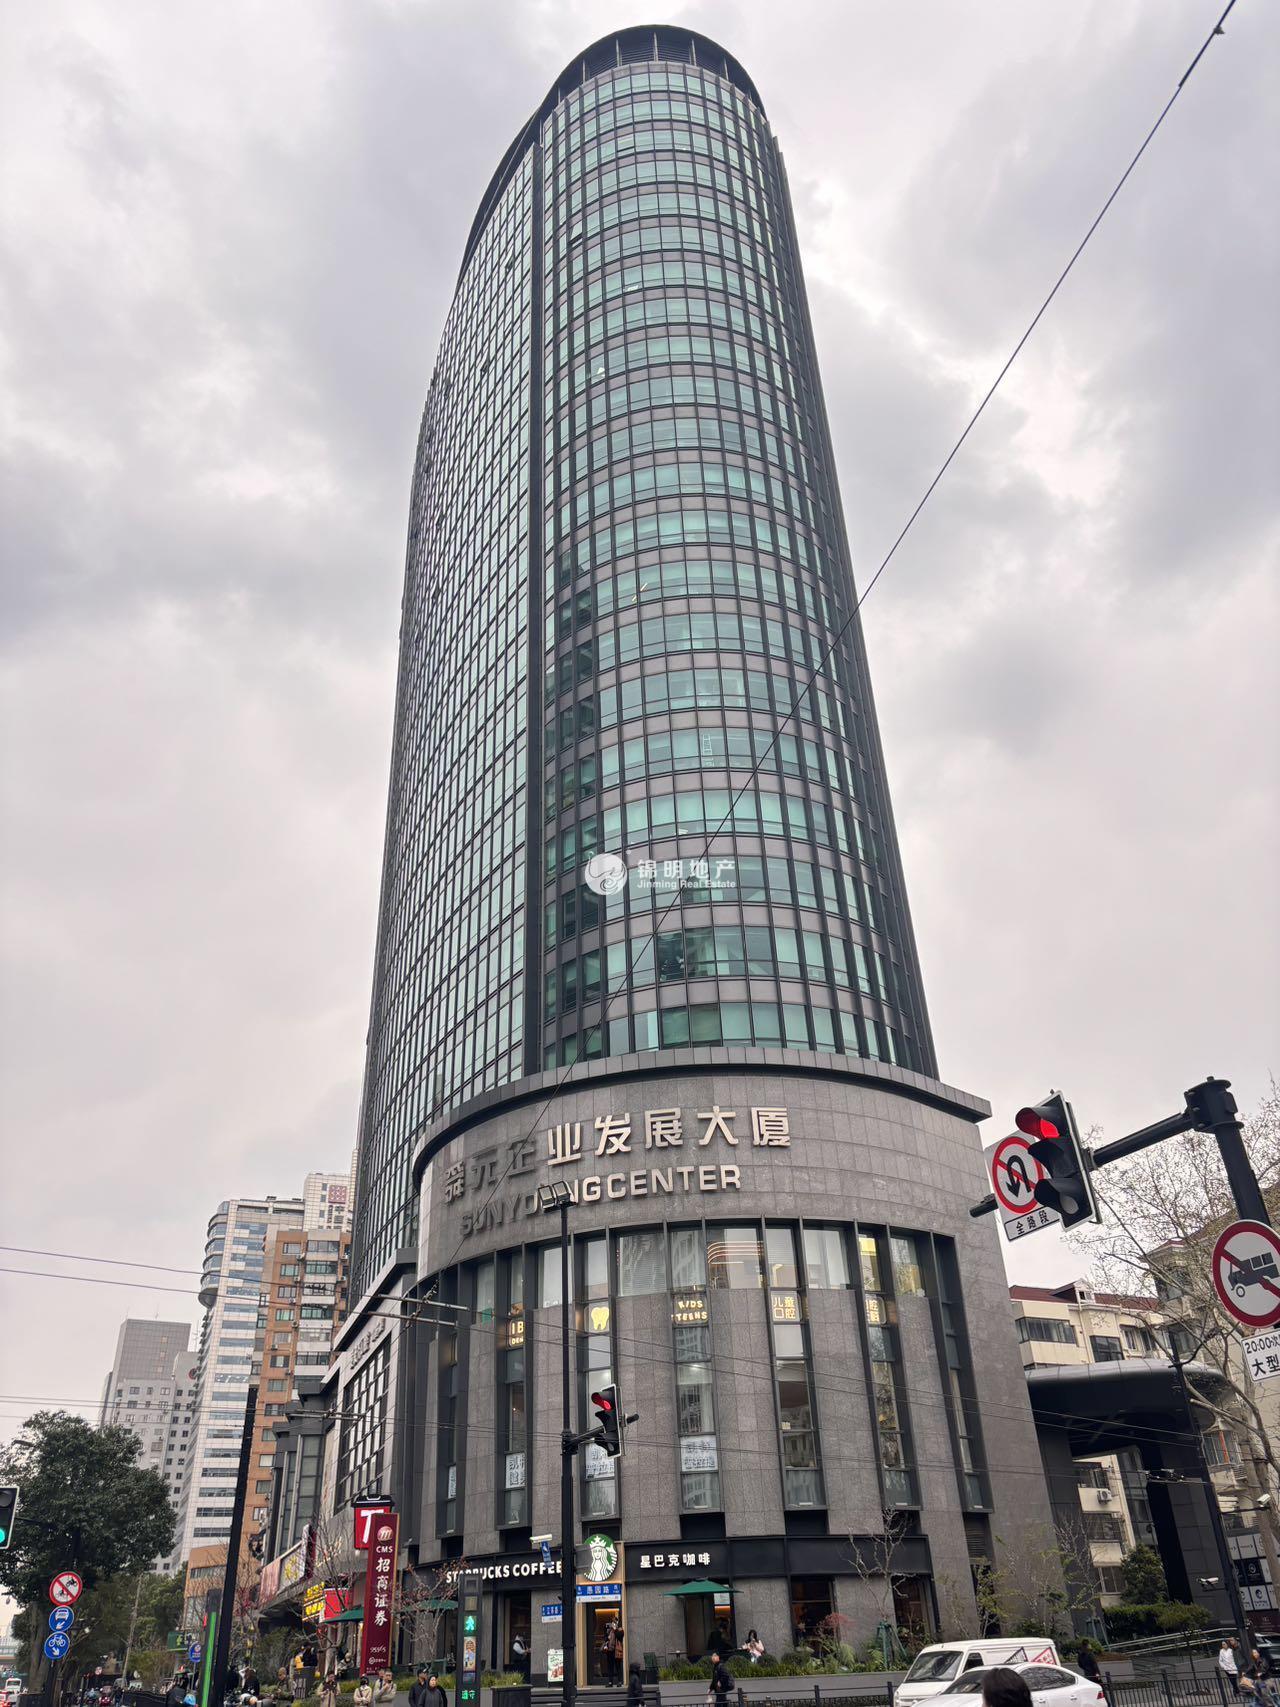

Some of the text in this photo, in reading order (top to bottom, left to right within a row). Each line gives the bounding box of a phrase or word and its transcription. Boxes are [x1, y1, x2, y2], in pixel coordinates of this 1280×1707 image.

[1016, 1209, 1050, 1236] 全路段
[773, 1296, 796, 1308] 儿童
[774, 1307, 796, 1319] 口腔
[1245, 1334, 1280, 1354] 20:00次
[376, 1545, 393, 1553] CMS
[640, 1552, 711, 1569] 星巴克咖啡
[373, 1557, 391, 1626] 招商证券
